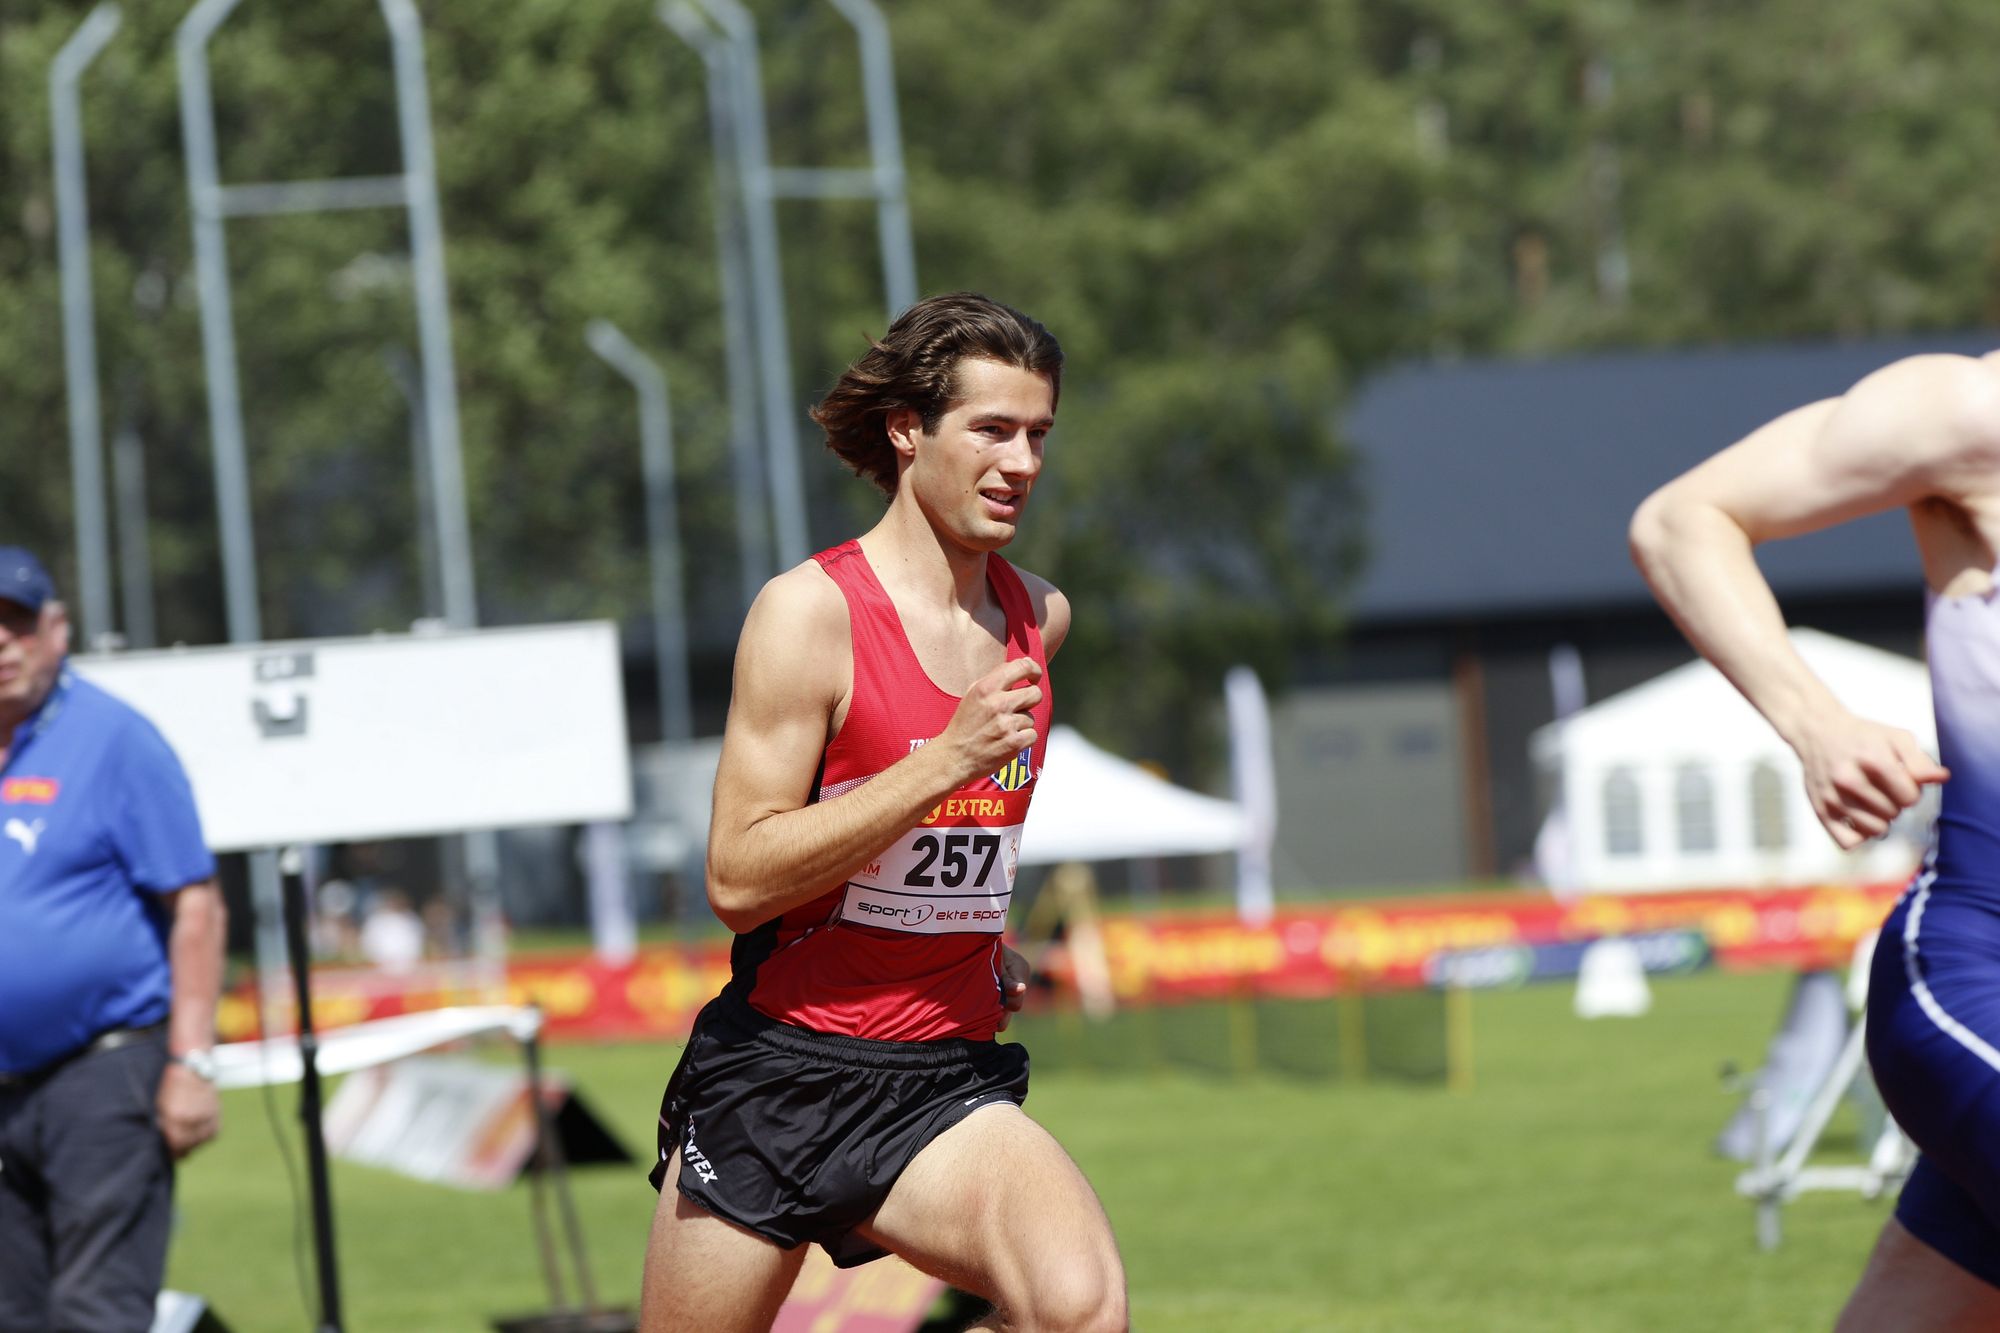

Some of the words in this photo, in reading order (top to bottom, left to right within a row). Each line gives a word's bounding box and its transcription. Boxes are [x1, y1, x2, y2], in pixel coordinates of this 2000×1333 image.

[945, 799, 1005, 817] EXTRA
[903, 834, 1001, 888] 257
[936, 909, 969, 921] ekte
